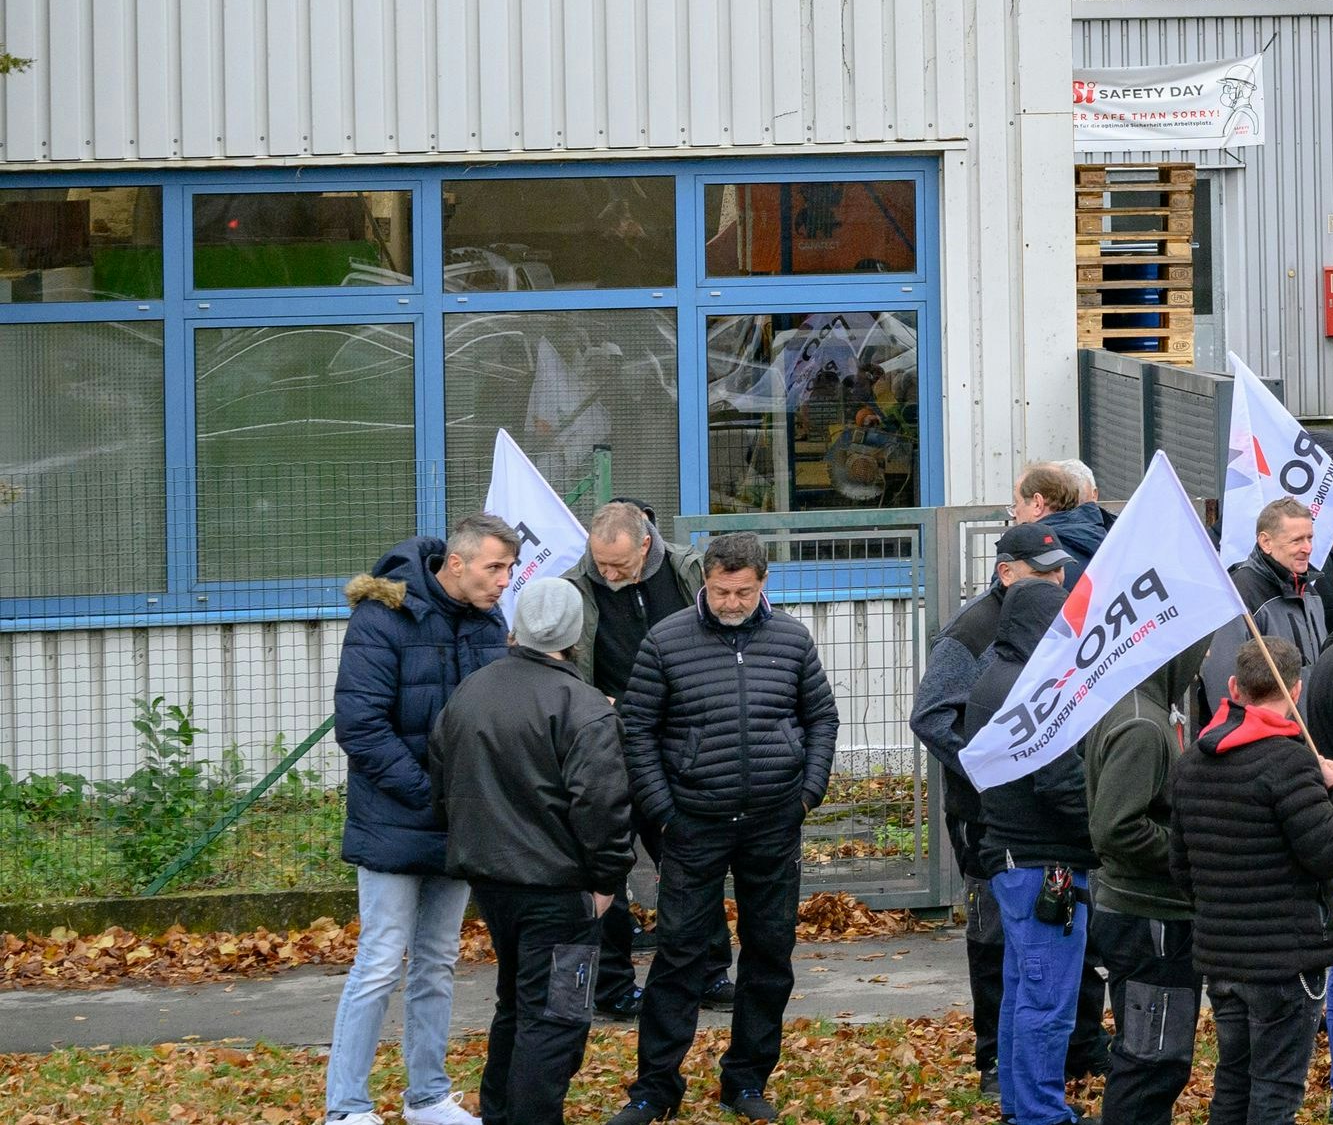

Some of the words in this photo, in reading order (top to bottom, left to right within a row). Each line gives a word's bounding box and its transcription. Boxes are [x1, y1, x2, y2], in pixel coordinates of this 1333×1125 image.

[1100, 87, 1165, 99] SAFETY
[1170, 84, 1204, 98] DAY
[1094, 112, 1126, 121] SAFE
[1131, 111, 1167, 121] THAN
[1172, 109, 1221, 119] SORRY!
[1101, 122, 1130, 130] optimale
[1130, 121, 1162, 129] Sicherheit
